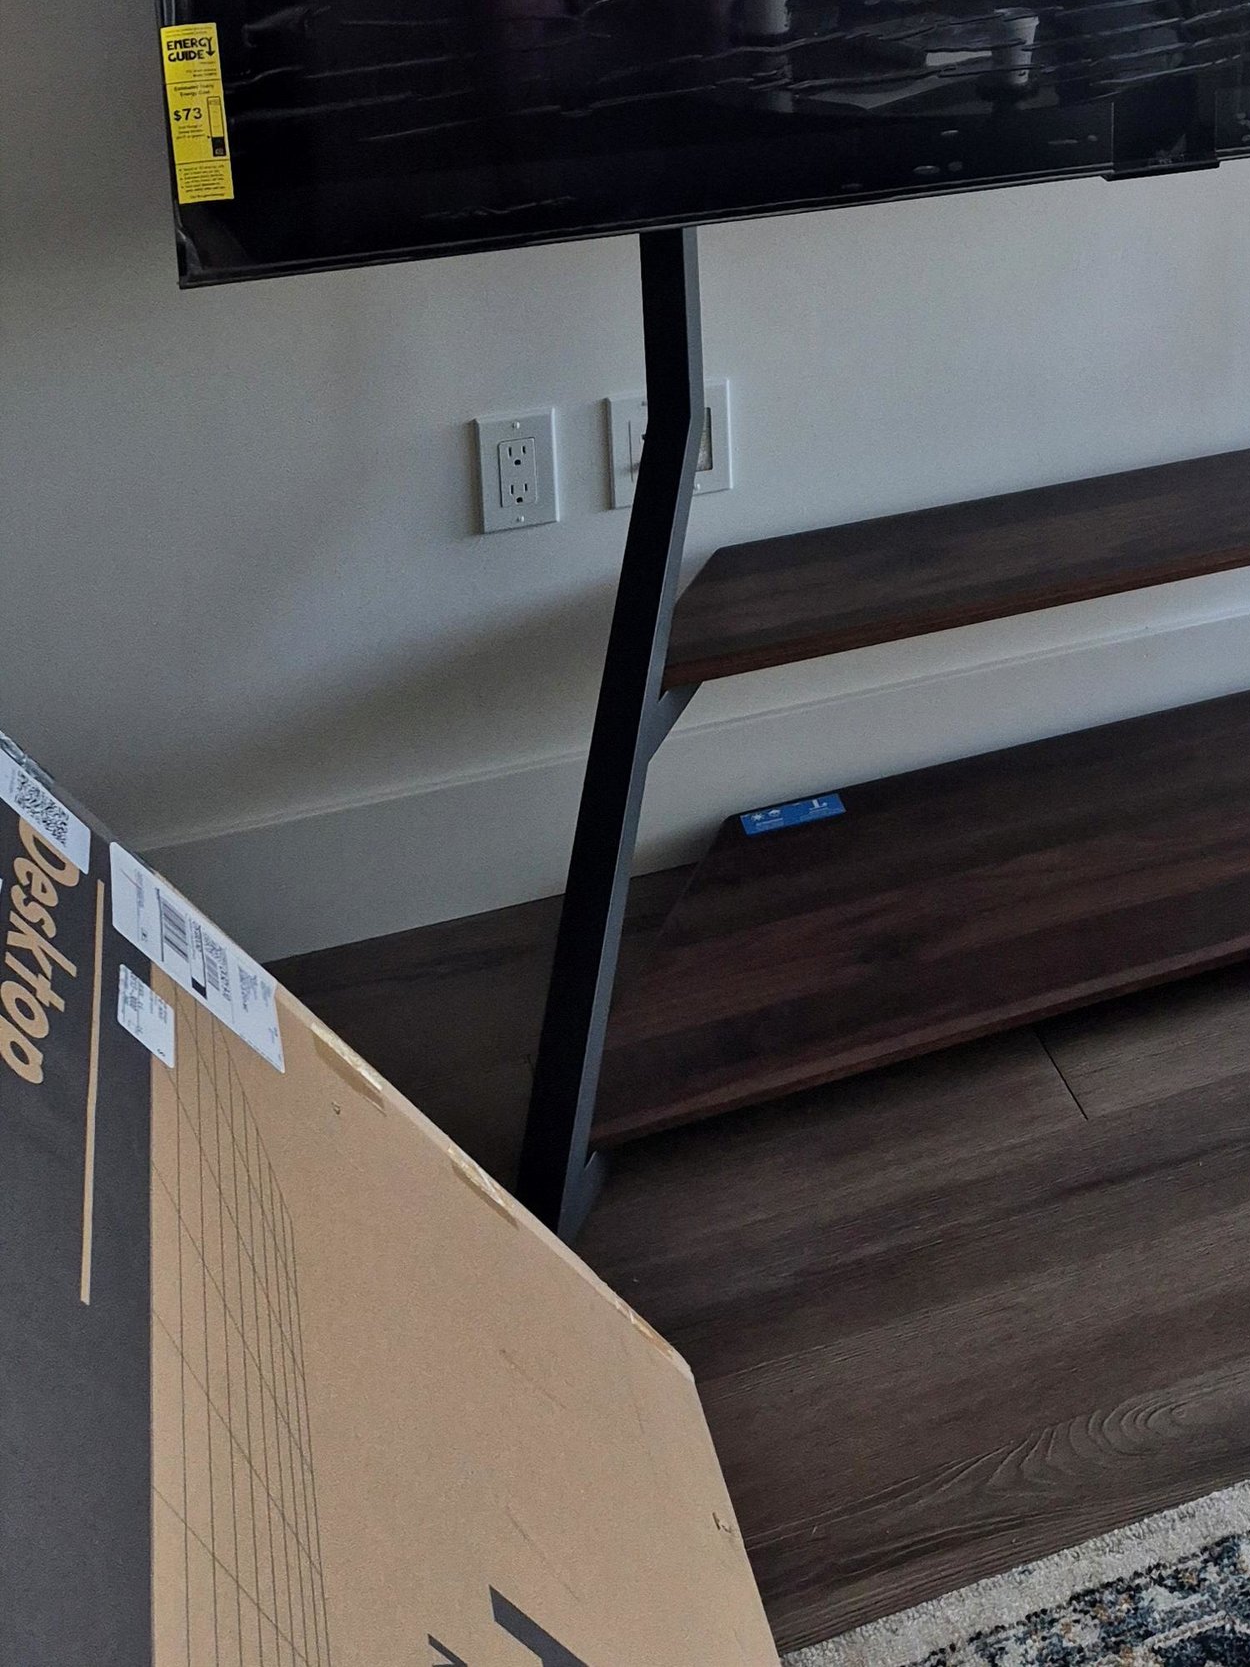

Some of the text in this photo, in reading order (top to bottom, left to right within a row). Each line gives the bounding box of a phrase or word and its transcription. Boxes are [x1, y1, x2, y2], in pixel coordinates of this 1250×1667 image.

[166, 37, 214, 55] ENERGY
[168, 49, 204, 62] GUIDE
[173, 107, 203, 122] $73
[0, 818, 80, 1085] Desktop
